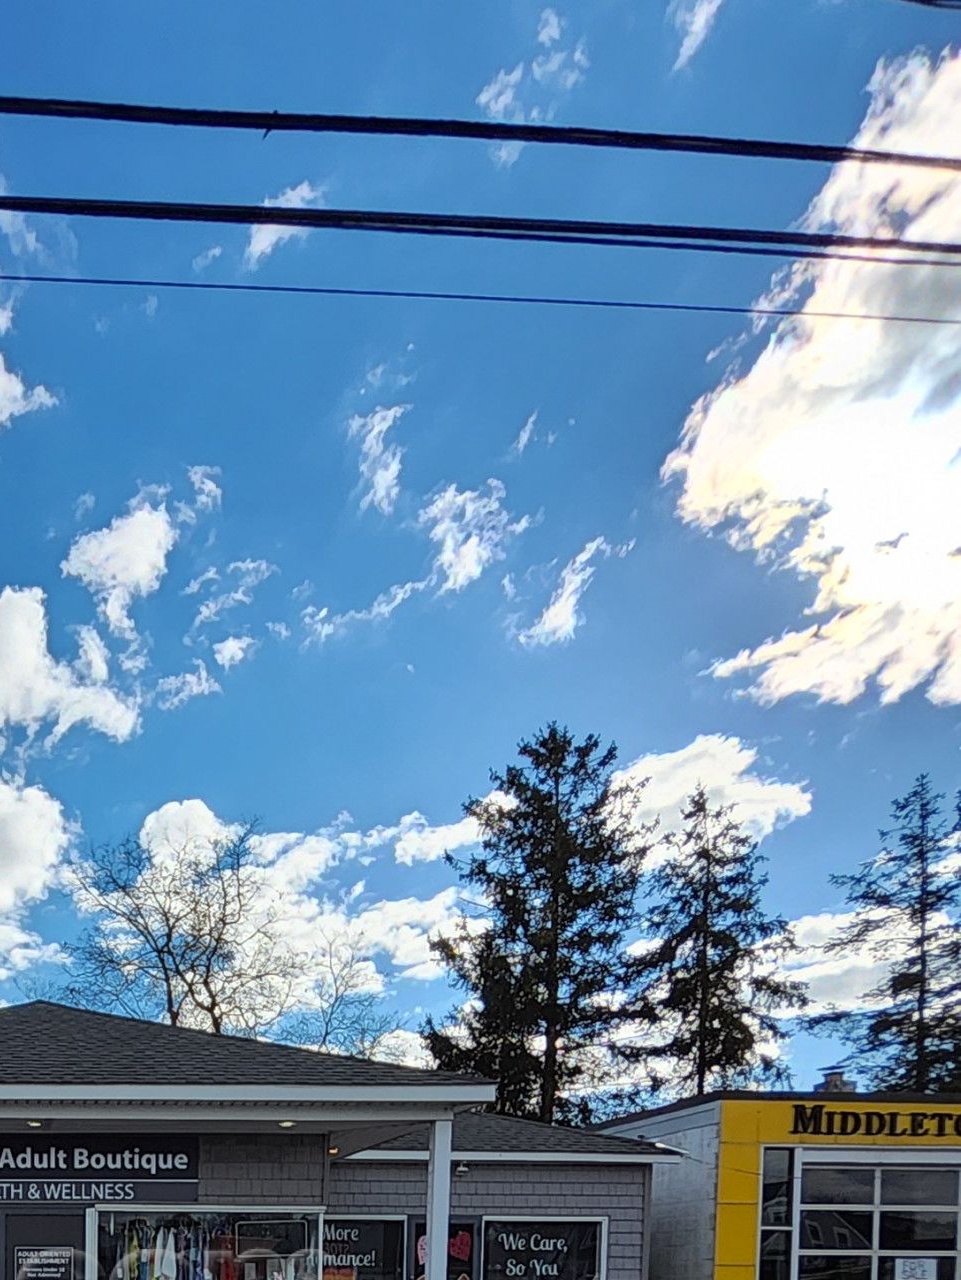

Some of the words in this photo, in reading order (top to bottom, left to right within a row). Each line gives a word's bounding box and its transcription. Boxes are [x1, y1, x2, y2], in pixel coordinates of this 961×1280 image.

[73, 1147, 188, 1174] Boutique
[27, 1183, 40, 1199] &
[43, 1183, 135, 1199] WELLNESS
[323, 1224, 359, 1240] More
[498, 1233, 526, 1250] We
[530, 1233, 568, 1253] Care,
[506, 1259, 526, 1276] So
[529, 1259, 559, 1275] You
